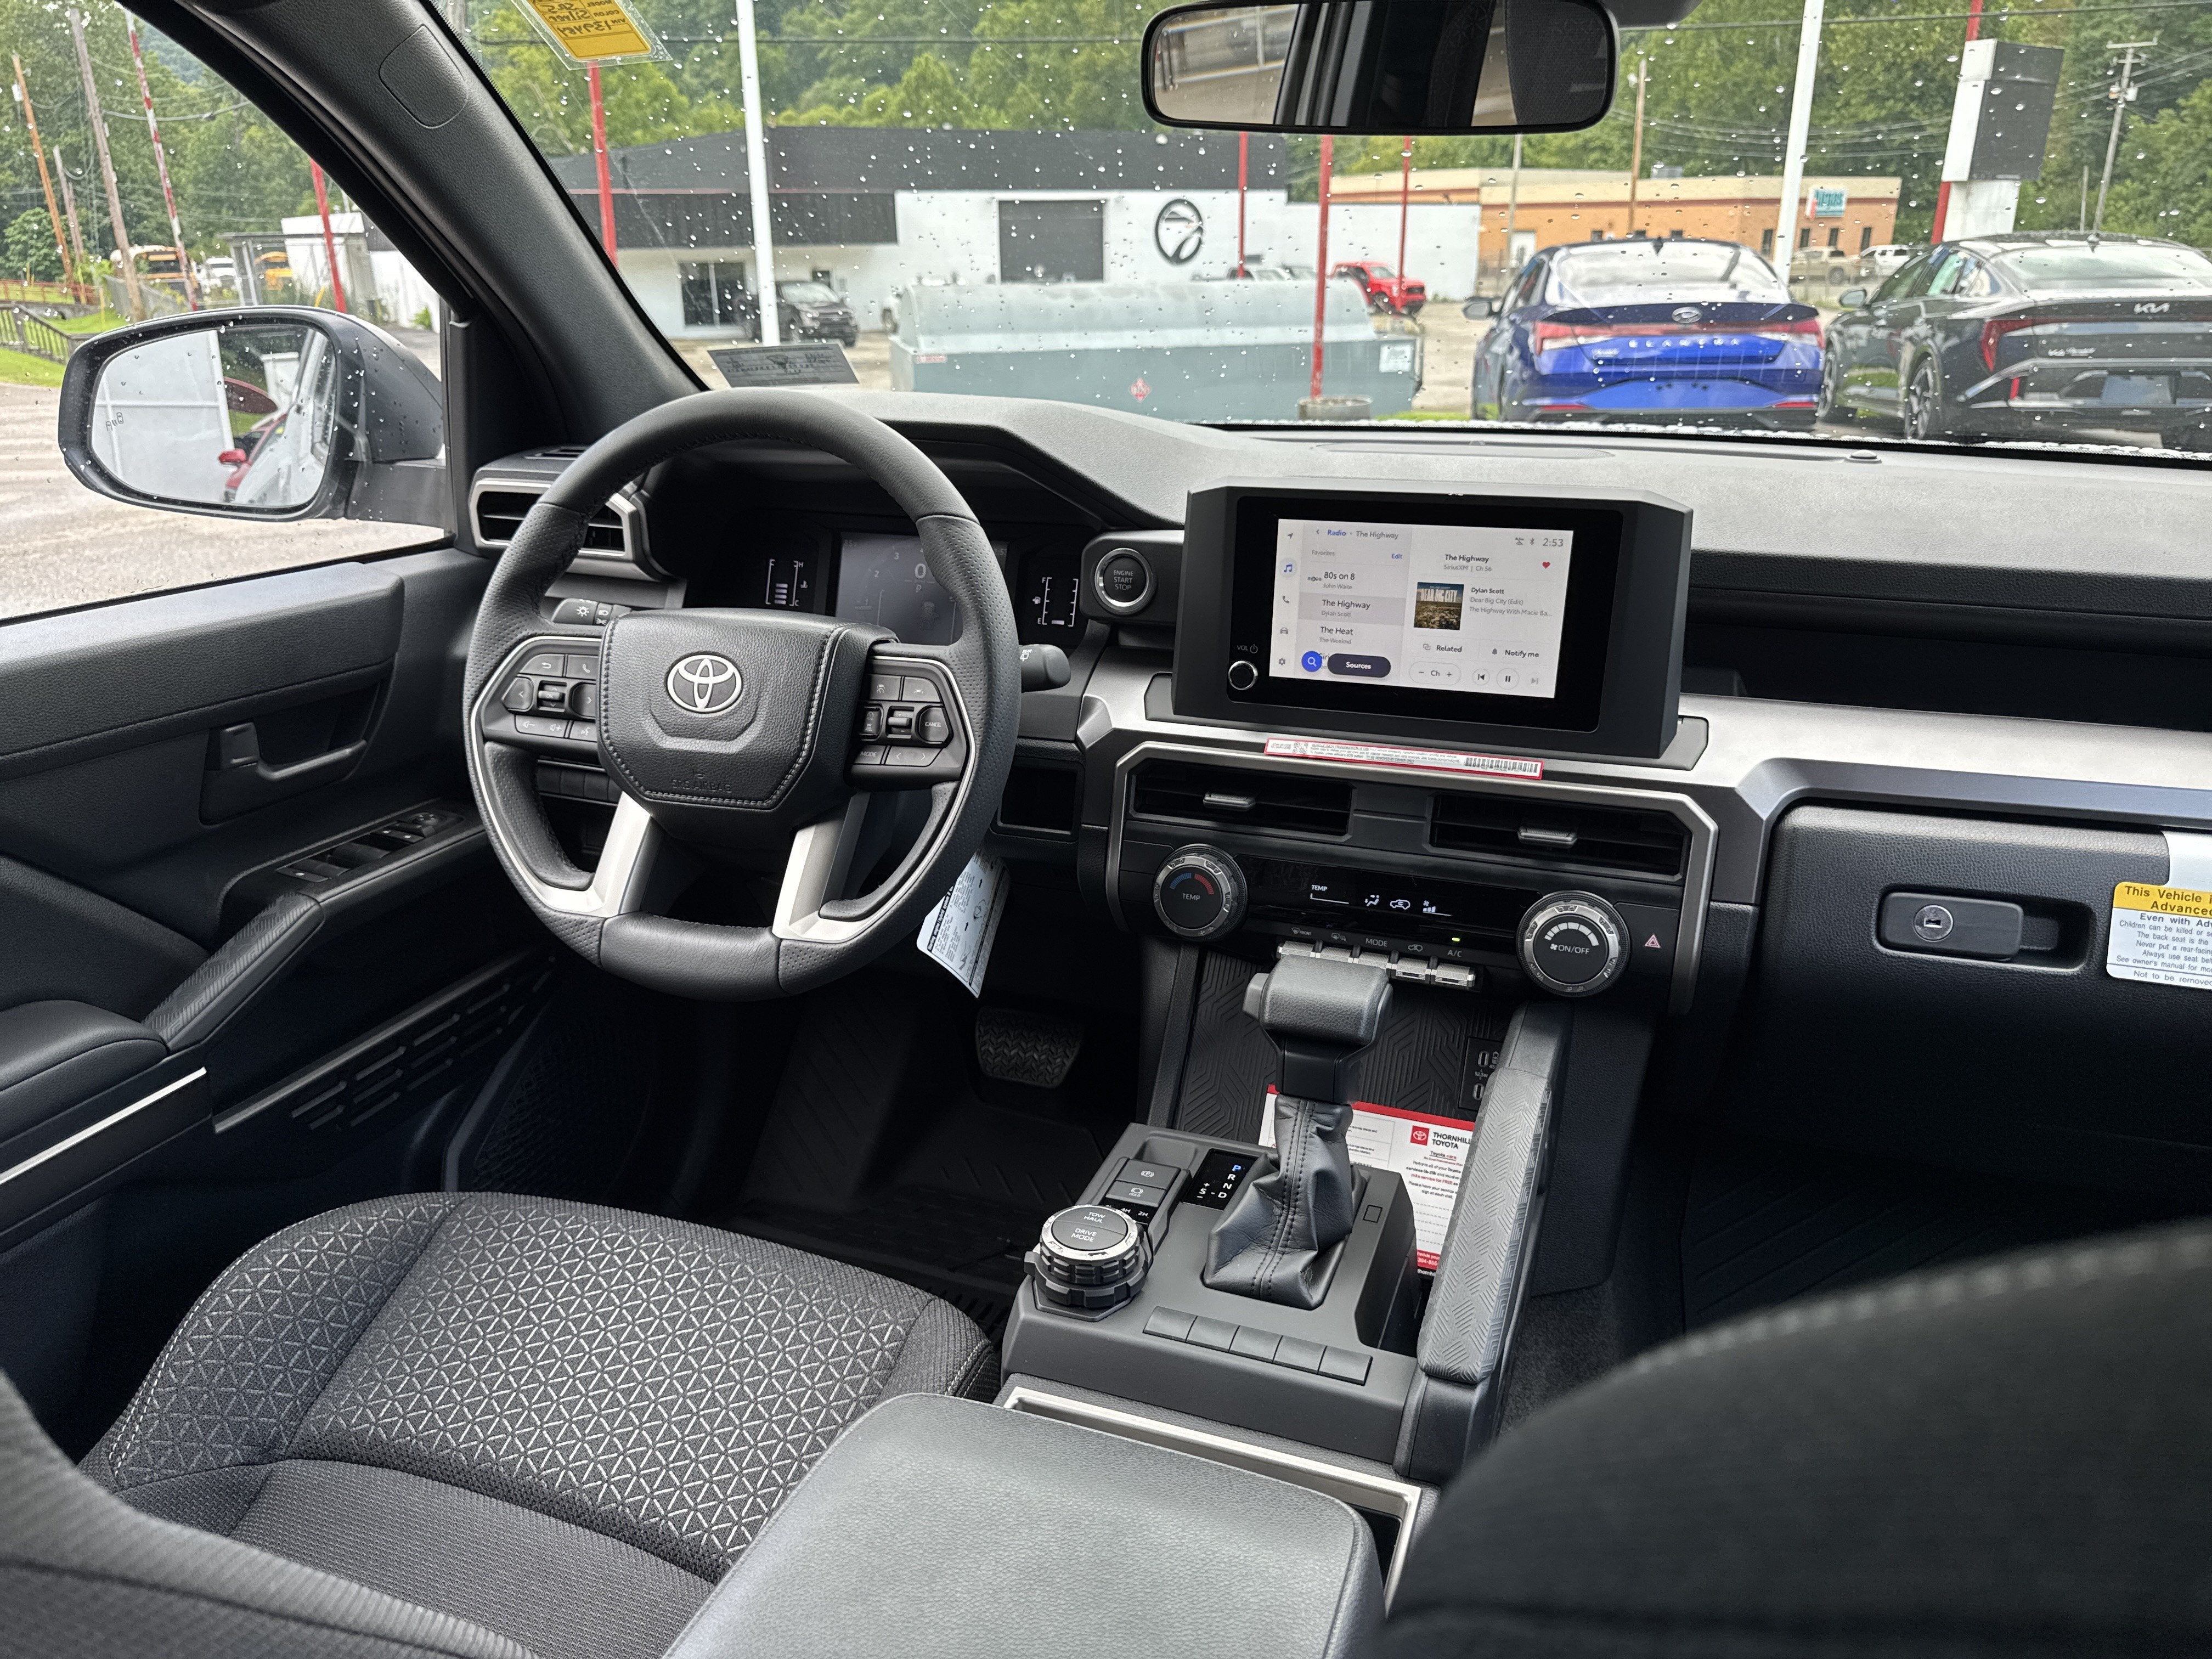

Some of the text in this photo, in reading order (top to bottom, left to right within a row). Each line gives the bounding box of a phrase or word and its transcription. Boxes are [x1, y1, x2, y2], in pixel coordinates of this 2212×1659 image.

[1370, 531, 1398, 540] Highway
[1543, 538, 1564, 547] 2:53
[1459, 555, 1489, 563] Highway
[916, 584, 922, 593] P
[1338, 600, 1370, 610] Highway
[1505, 650, 1526, 658] Notify
[1345, 661, 1372, 669] Sources
[1182, 893, 1200, 901] TEMP
[2125, 885, 2150, 896] This
[2158, 889, 2202, 902] Vehicle
[2140, 913, 2164, 922] Even
[2170, 917, 2190, 926] with
[2119, 919, 2146, 929] Children
[2176, 927, 2193, 935] killed
[1365, 938, 1388, 947] MODE
[2136, 940, 2155, 949] Never
[1448, 949, 1462, 958] A/C
[1558, 944, 1590, 955] ON/OFF
[2142, 950, 2165, 960] Always
[2116, 955, 2129, 963] See
[2132, 958, 2157, 967] owner's
[2161, 961, 2185, 970] manual
[2134, 970, 2147, 978] Not
[1433, 1132, 1471, 1144] THORNHILL
[1432, 1139, 1458, 1149] TOYOTA
[1075, 1228, 1097, 1237] DRIVE
[1071, 1233, 1094, 1242] MODE
